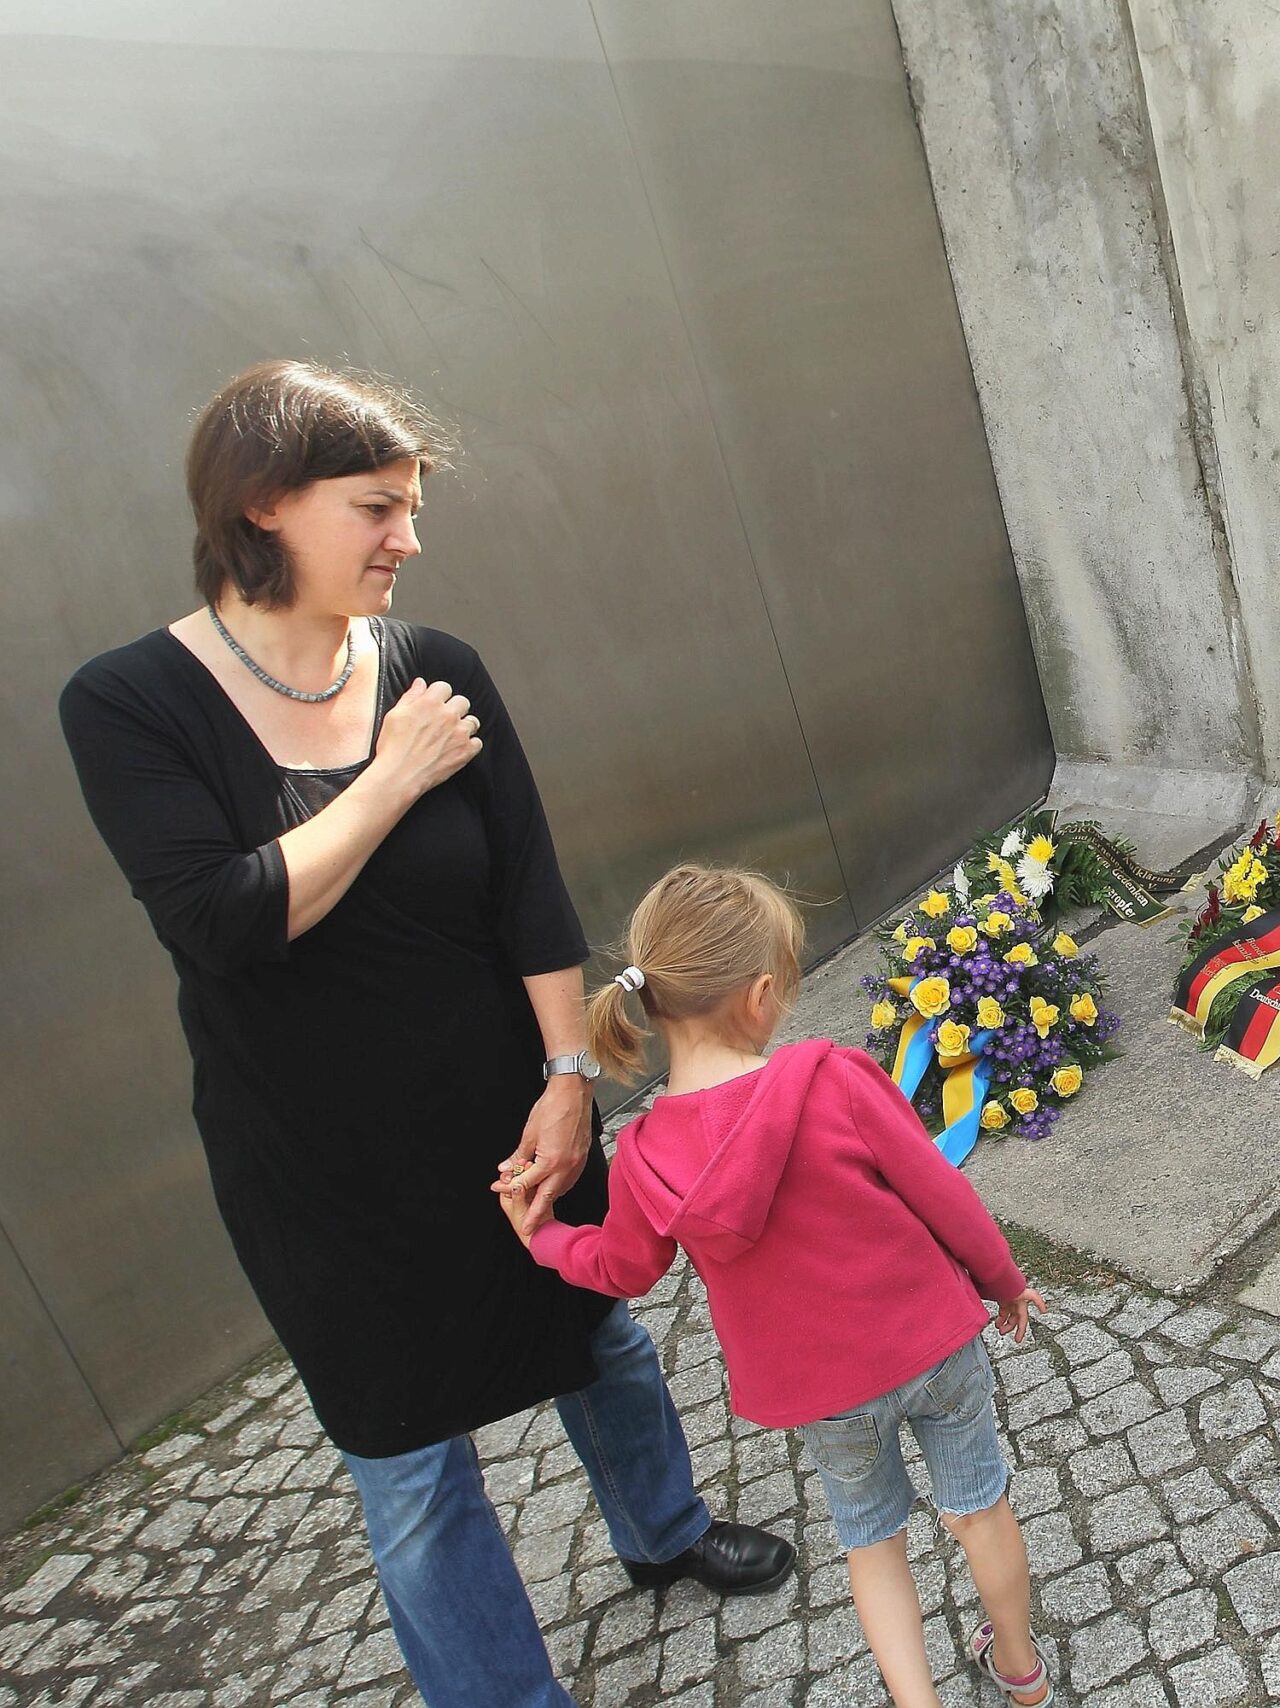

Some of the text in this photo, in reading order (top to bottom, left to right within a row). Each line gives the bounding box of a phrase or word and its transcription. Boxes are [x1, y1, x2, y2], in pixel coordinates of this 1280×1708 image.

[1123, 855, 1175, 884] Aufklärung
[1106, 886, 1136, 918] eropfer
[1112, 868, 1149, 907] Gedenken
